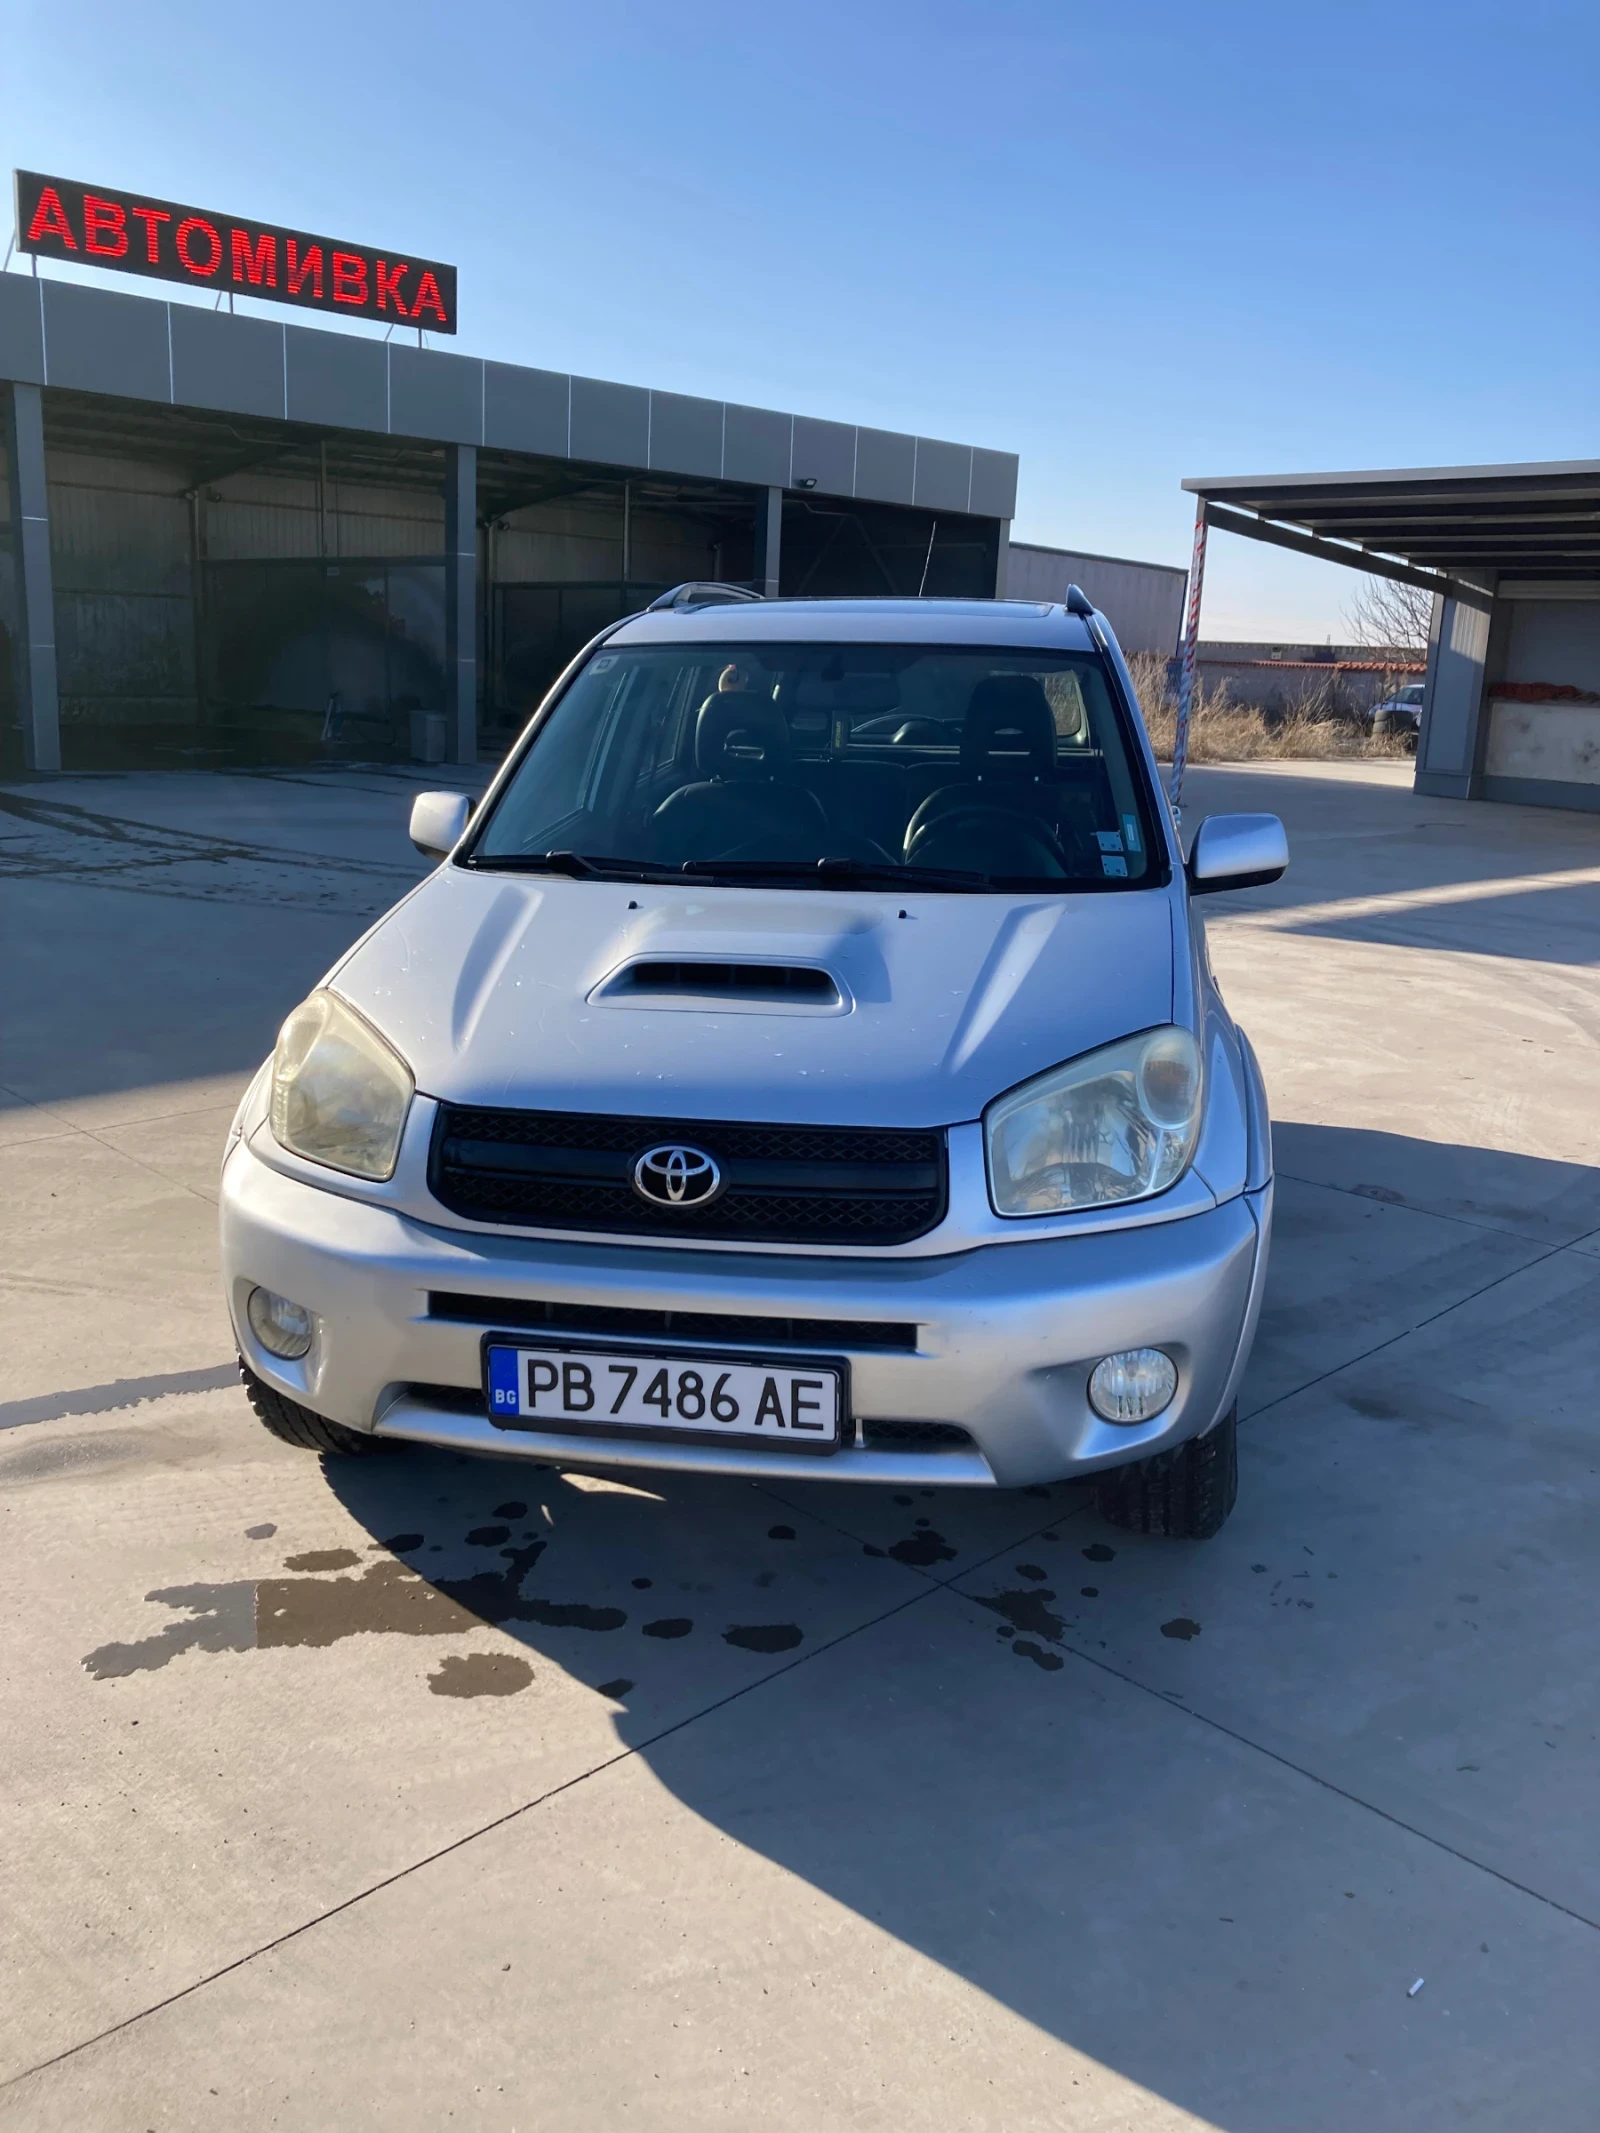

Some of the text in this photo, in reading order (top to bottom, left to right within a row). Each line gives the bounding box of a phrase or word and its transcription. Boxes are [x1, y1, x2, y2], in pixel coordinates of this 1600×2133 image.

[28, 186, 447, 322] АВТОМИВКА
[494, 1389, 517, 1405] BG
[527, 1358, 824, 1431] PB 7486 AE
